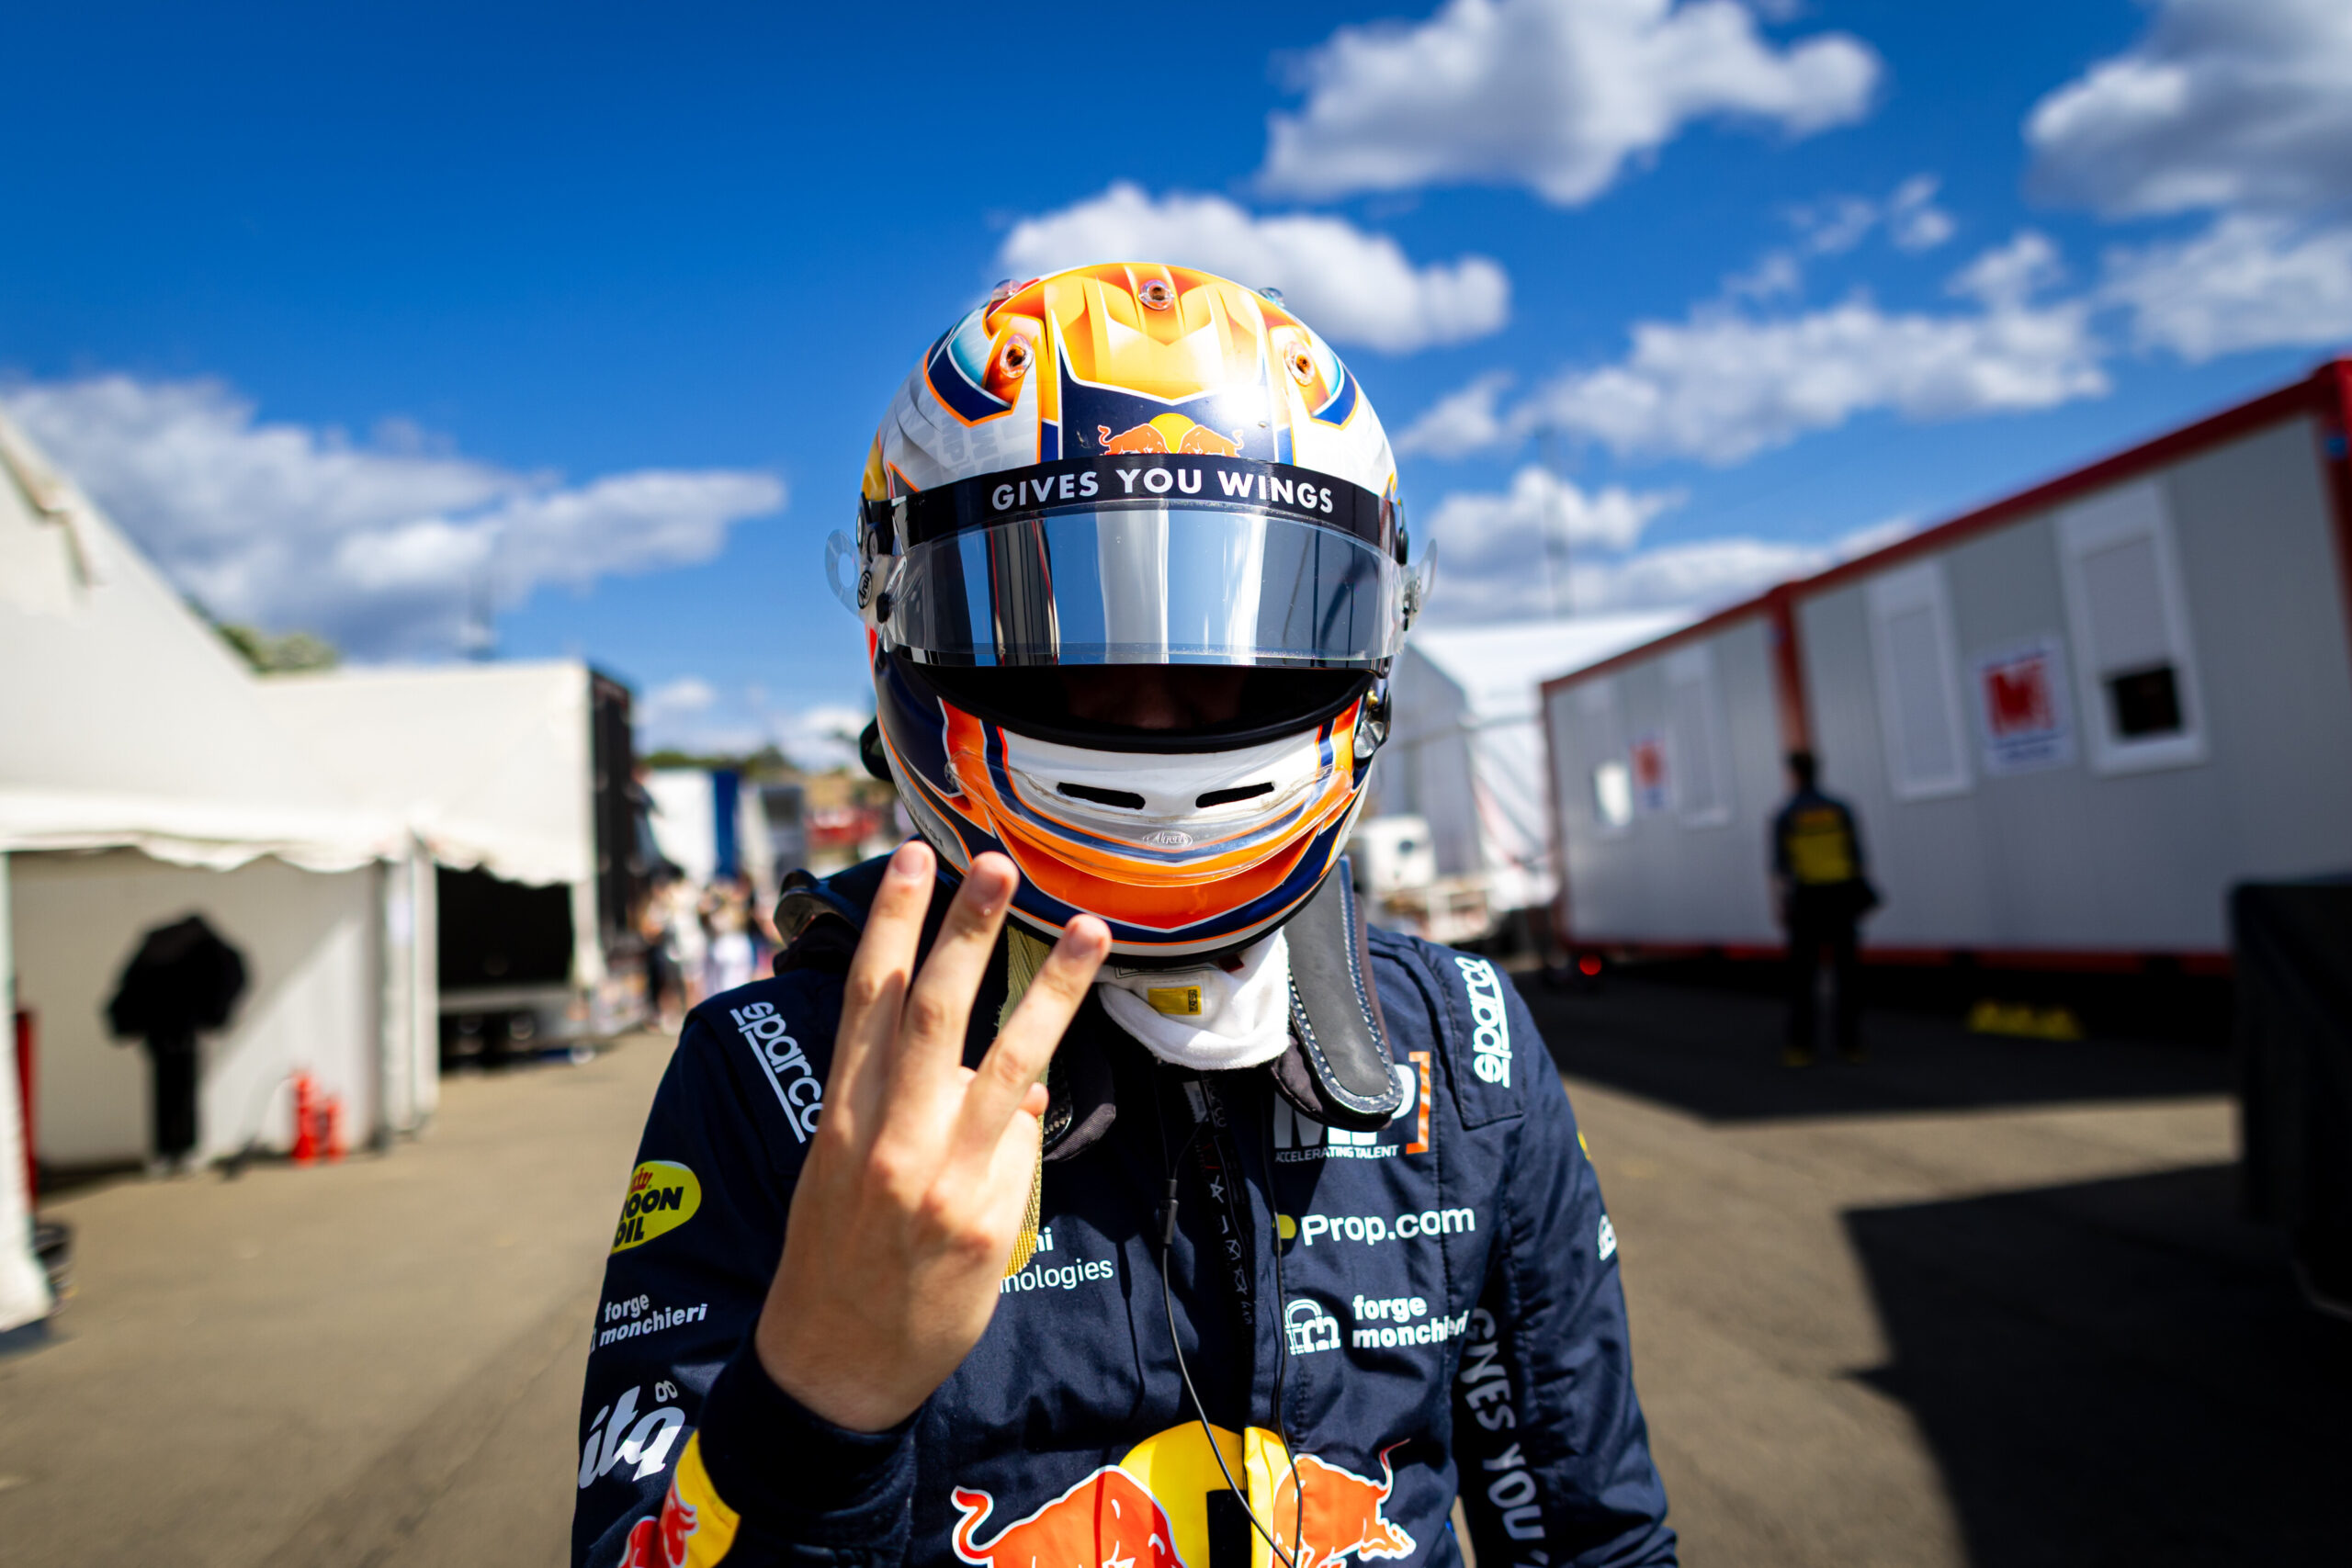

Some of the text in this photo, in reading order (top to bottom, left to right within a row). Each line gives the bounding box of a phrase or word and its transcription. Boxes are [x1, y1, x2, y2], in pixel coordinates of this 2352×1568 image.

[991, 468, 1334, 514] GIVES YOU WINGS
[1454, 956, 1512, 1088] sparco
[730, 1002, 824, 1143] sparco
[1274, 1145, 1399, 1163] ACCELERATING TALENT
[620, 1186, 684, 1219] OON
[614, 1216, 645, 1248] OIL
[1301, 1208, 1476, 1247] Prop.com
[1000, 1258, 1114, 1293] nologies
[599, 1303, 708, 1348] monchieri
[605, 1293, 650, 1324] forge
[1352, 1294, 1428, 1324] forge
[1483, 1442, 1545, 1540] YOU
